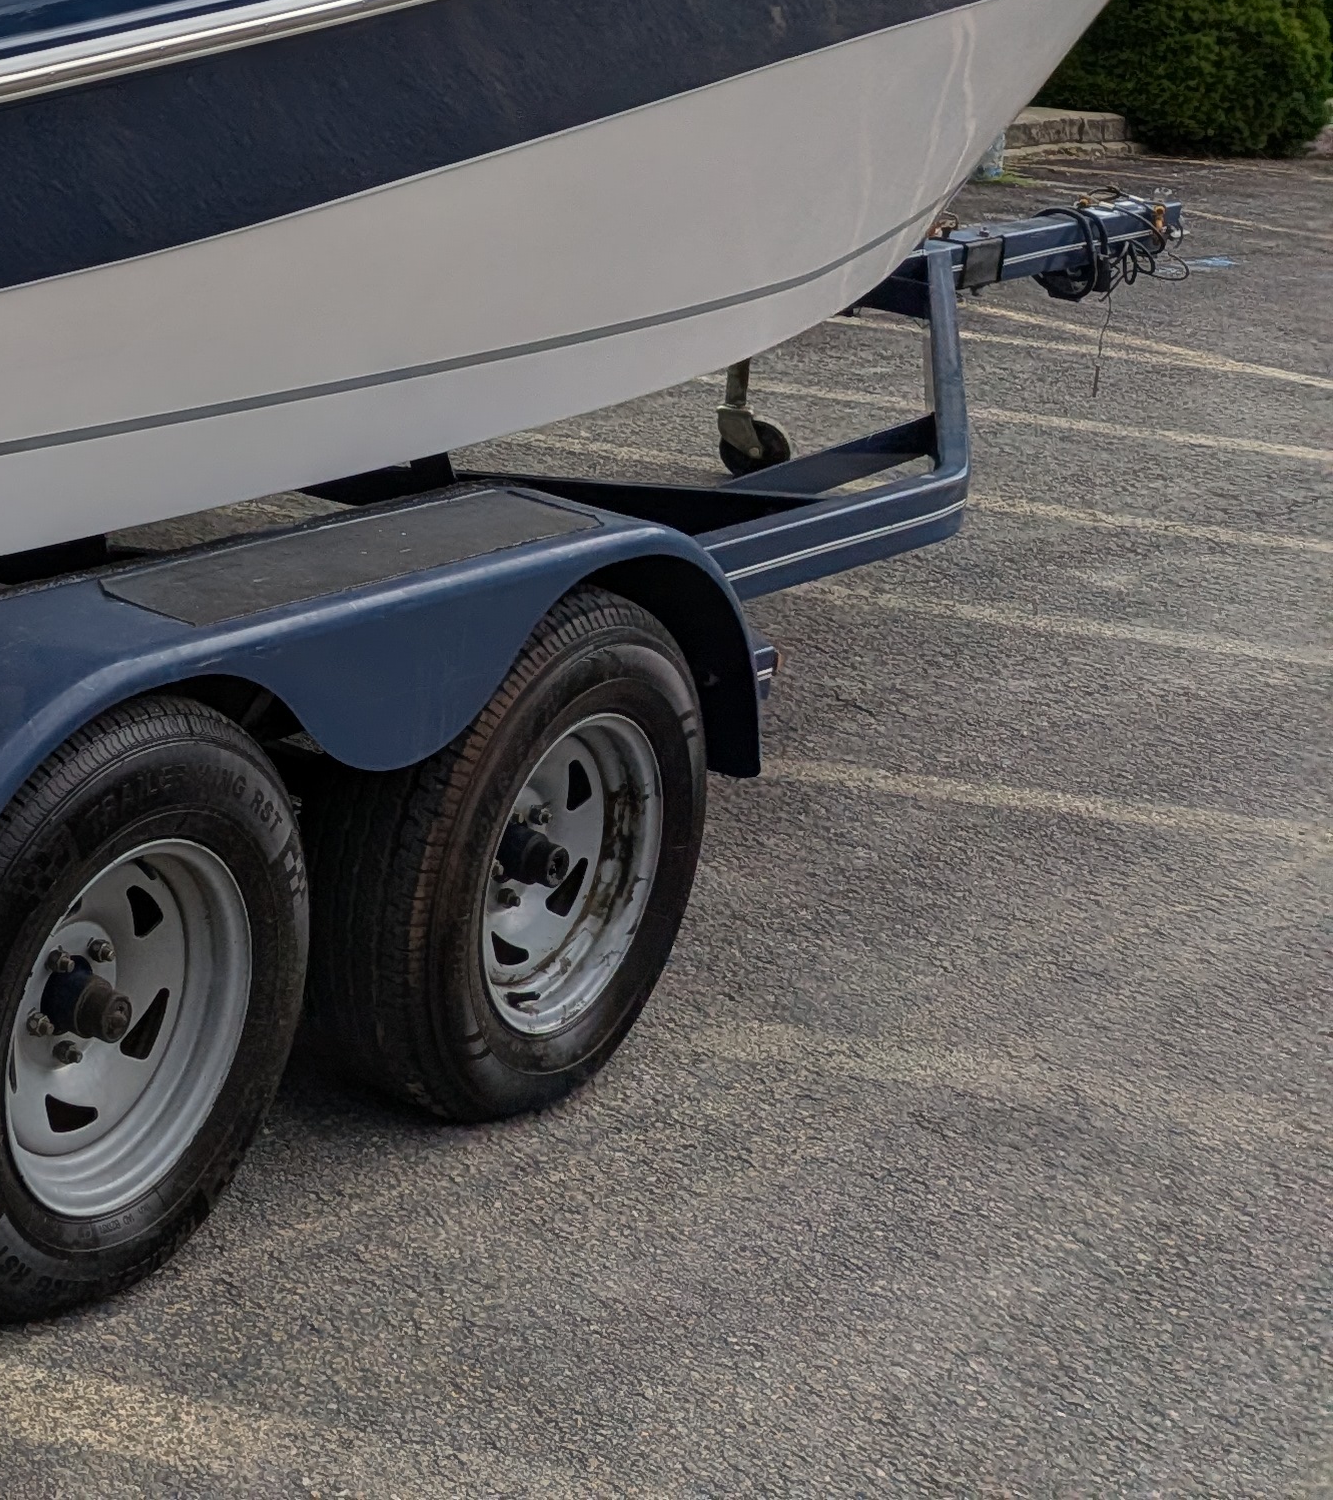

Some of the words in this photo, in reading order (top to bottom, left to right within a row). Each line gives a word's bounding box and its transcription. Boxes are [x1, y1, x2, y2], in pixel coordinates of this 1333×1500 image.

[85, 762, 188, 831] TRAILER
[196, 762, 248, 797] KING
[250, 785, 284, 833] RST
